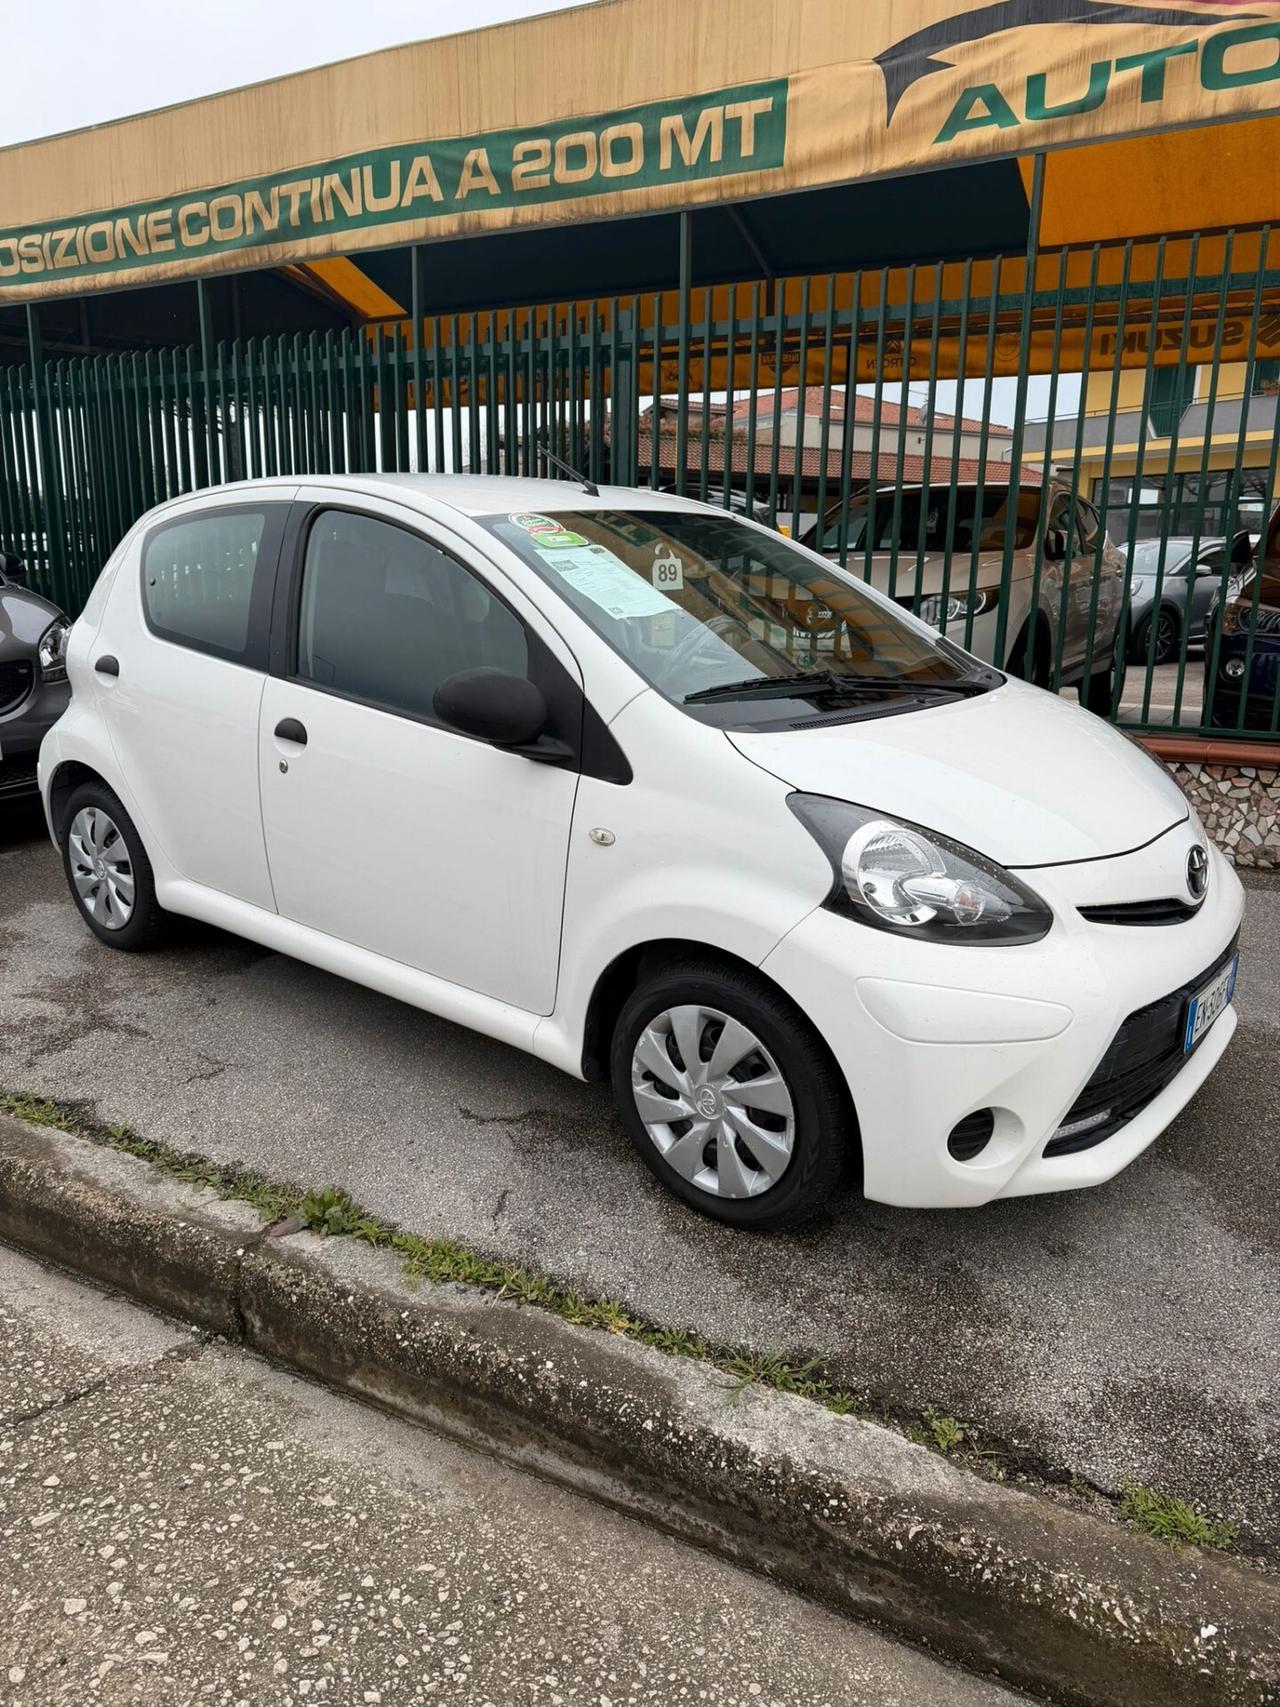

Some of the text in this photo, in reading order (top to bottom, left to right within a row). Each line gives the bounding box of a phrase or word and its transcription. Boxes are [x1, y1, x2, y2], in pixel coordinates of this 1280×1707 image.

[932, 22, 1280, 144] AUTO
[179, 156, 444, 248] CONTINUA
[455, 148, 501, 199] A
[512, 123, 644, 192] 200
[659, 97, 774, 172] MT
[658, 564, 677, 582] 89
